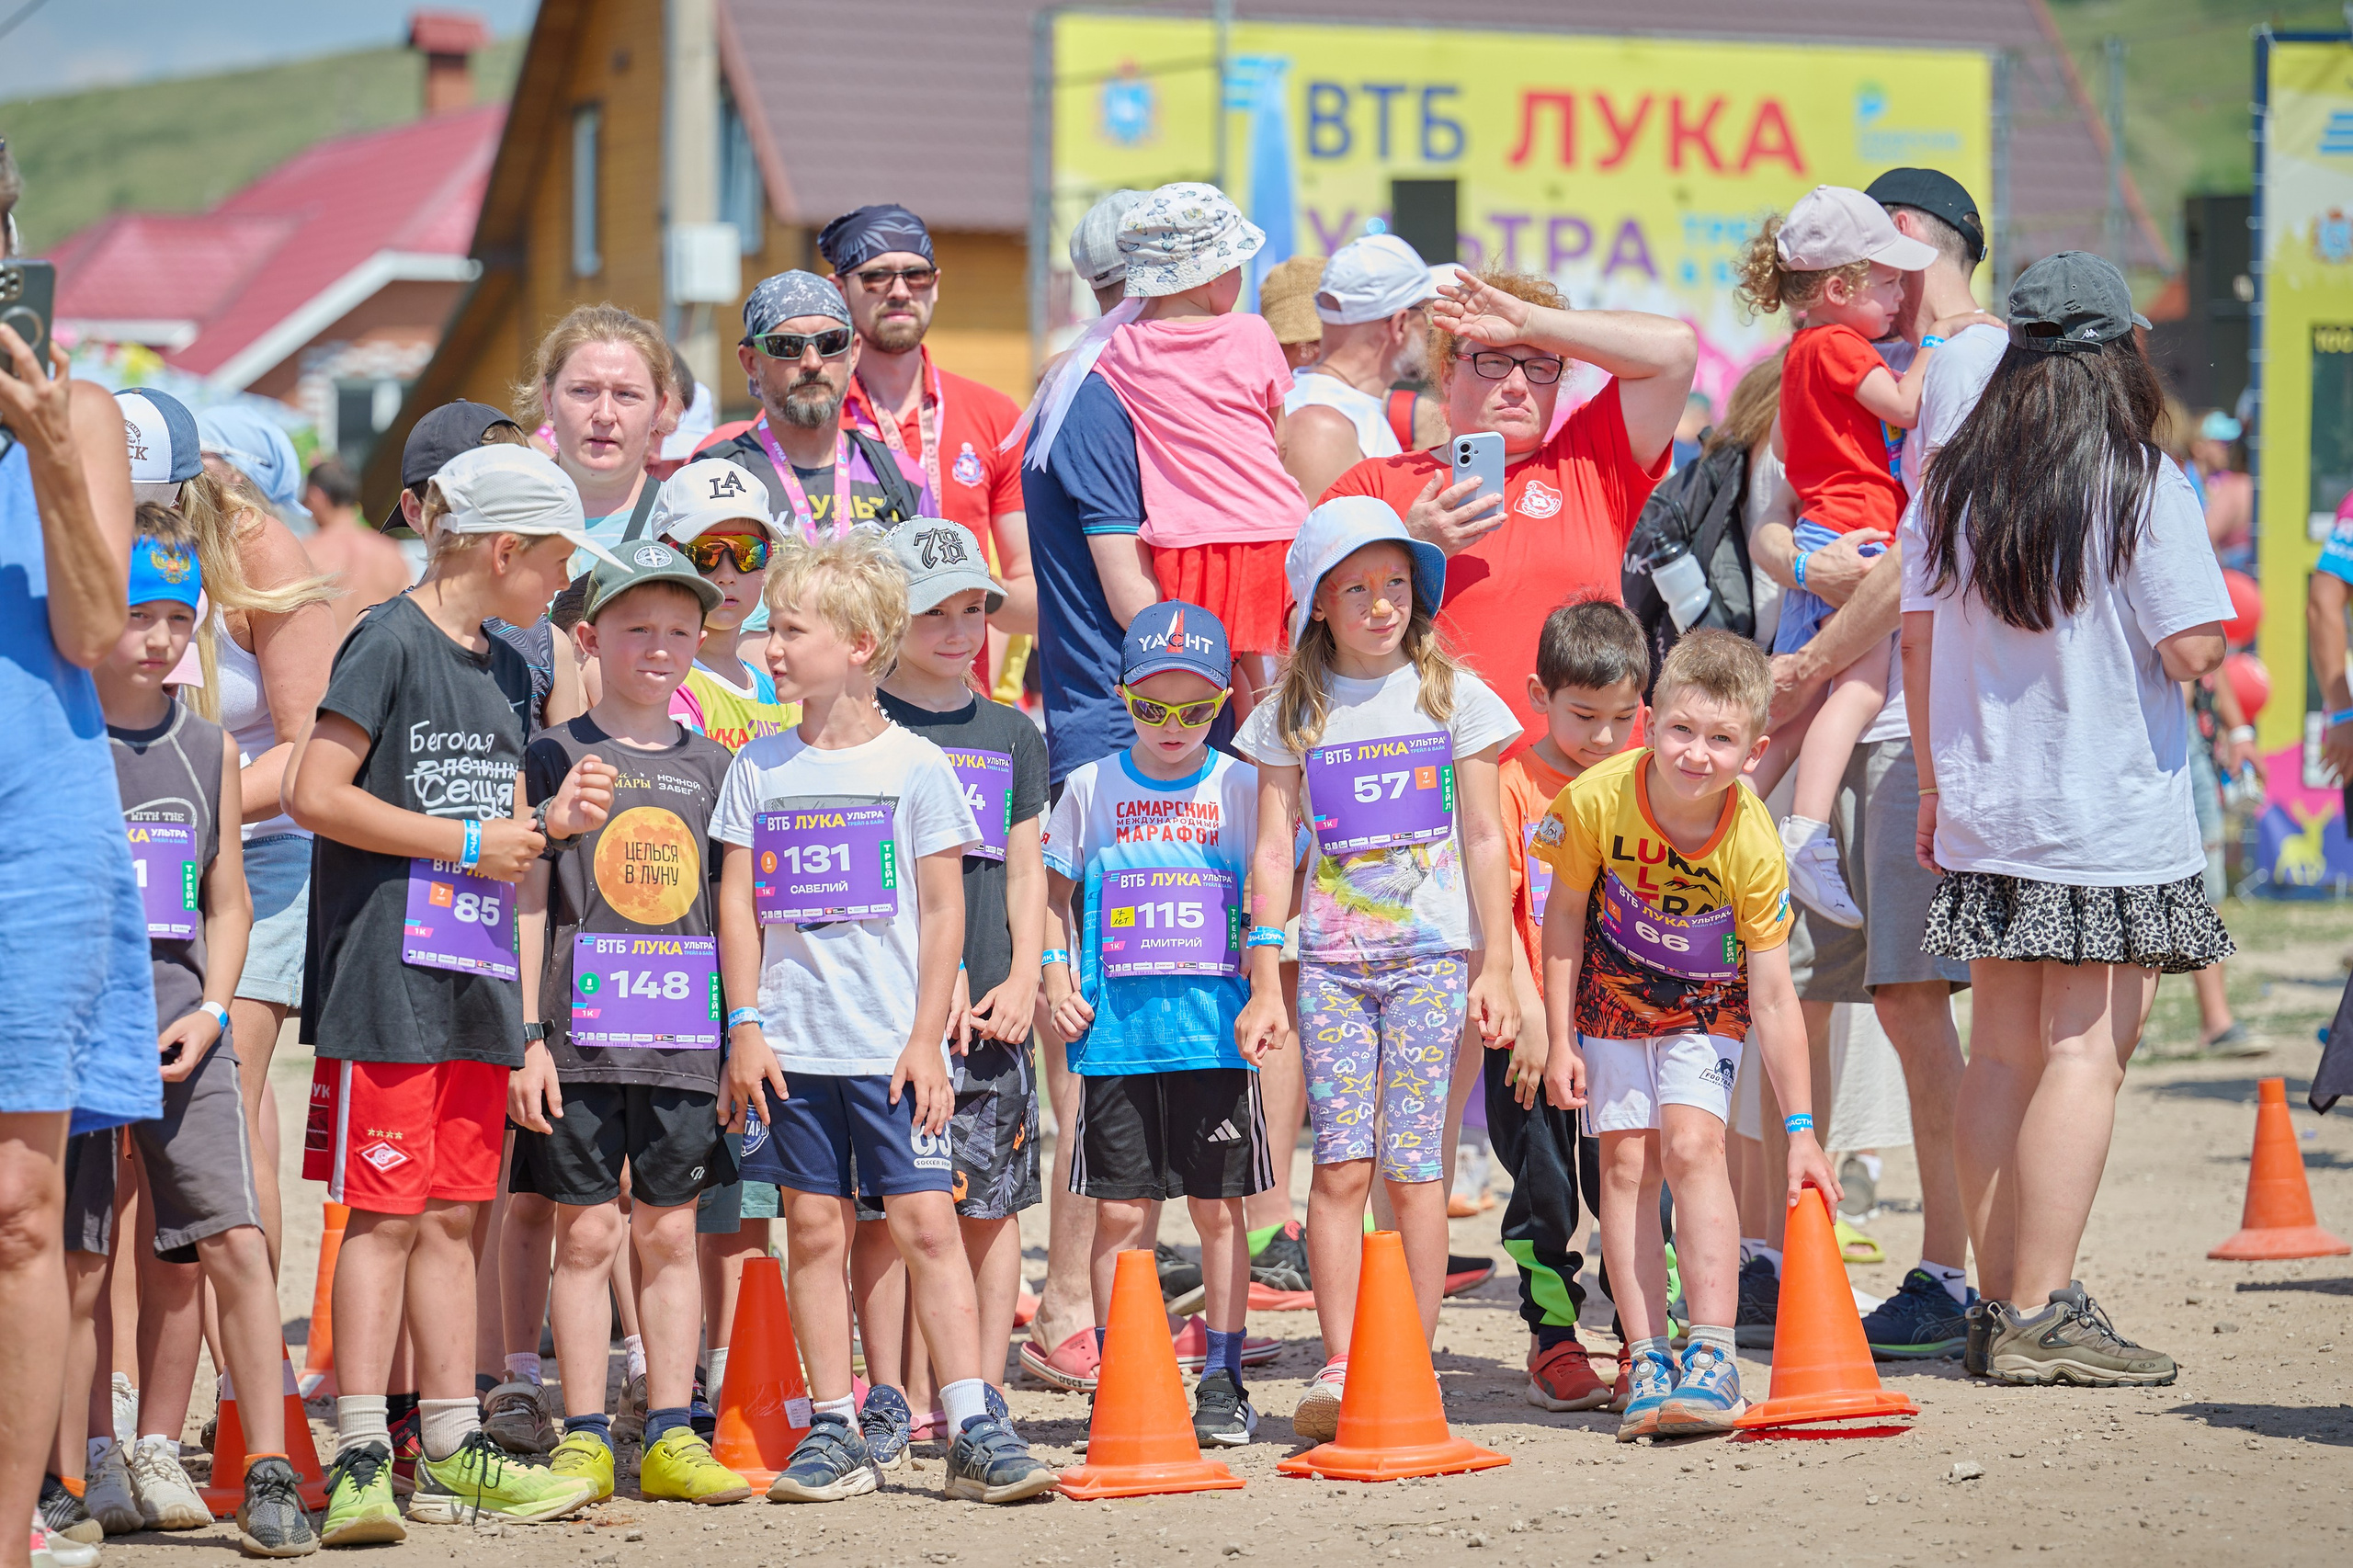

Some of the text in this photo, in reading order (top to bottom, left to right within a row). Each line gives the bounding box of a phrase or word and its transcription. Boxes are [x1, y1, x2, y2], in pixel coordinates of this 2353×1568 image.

[1305, 81, 1808, 177] ВТБ ЛУКА
[1304, 208, 1660, 278] УТРА
[709, 471, 746, 499] LA
[914, 528, 968, 569] 78
[1138, 631, 1214, 654] YACHT
[986, 756, 1010, 767] УЛЬТРА
[1324, 736, 1446, 766] ВТБ ЛУКА УЛЬТРА
[657, 774, 700, 790] НОЧНОЙ
[658, 782, 694, 796] ЗАБЕГ
[1354, 770, 1411, 803] 57
[961, 782, 986, 811] 4
[131, 812, 185, 823] WITH THE
[767, 811, 885, 832] ВТБ ЛУКА УЛЬТРА
[1116, 800, 1220, 821] САМАРСКИЙ
[151, 828, 188, 838] УЛЬТРА
[1116, 816, 1220, 829] МЕЖДУНАРОДНЫЙ
[1116, 824, 1220, 847] МАРАФОН
[625, 842, 678, 863] ЦЕЛЬСЯ
[783, 843, 851, 874] 131
[625, 865, 679, 886] В ЛУНУ
[883, 844, 893, 887] ТРЕЙЛ
[186, 865, 194, 909] ТРЕЙЛ
[438, 887, 446, 896] 7
[790, 880, 848, 894] САВЕЛИЙ
[1120, 872, 1233, 889] ВТБ ЛУКА УЛЬТРА
[454, 892, 501, 927] 85
[1117, 910, 1125, 918] 7
[1137, 902, 1205, 929] 115
[1619, 884, 1728, 928] ВТБ ЛУКА УЛЬТРА
[1112, 917, 1130, 926] лет
[597, 939, 714, 955] ВТБ ЛУКА УЛЬТРА
[1141, 937, 1202, 949] ДМИТРИЙ
[1635, 921, 1690, 952] 66
[1726, 935, 1734, 962] ТРЕЙЛ
[586, 978, 593, 986] 8
[609, 970, 690, 999] 148
